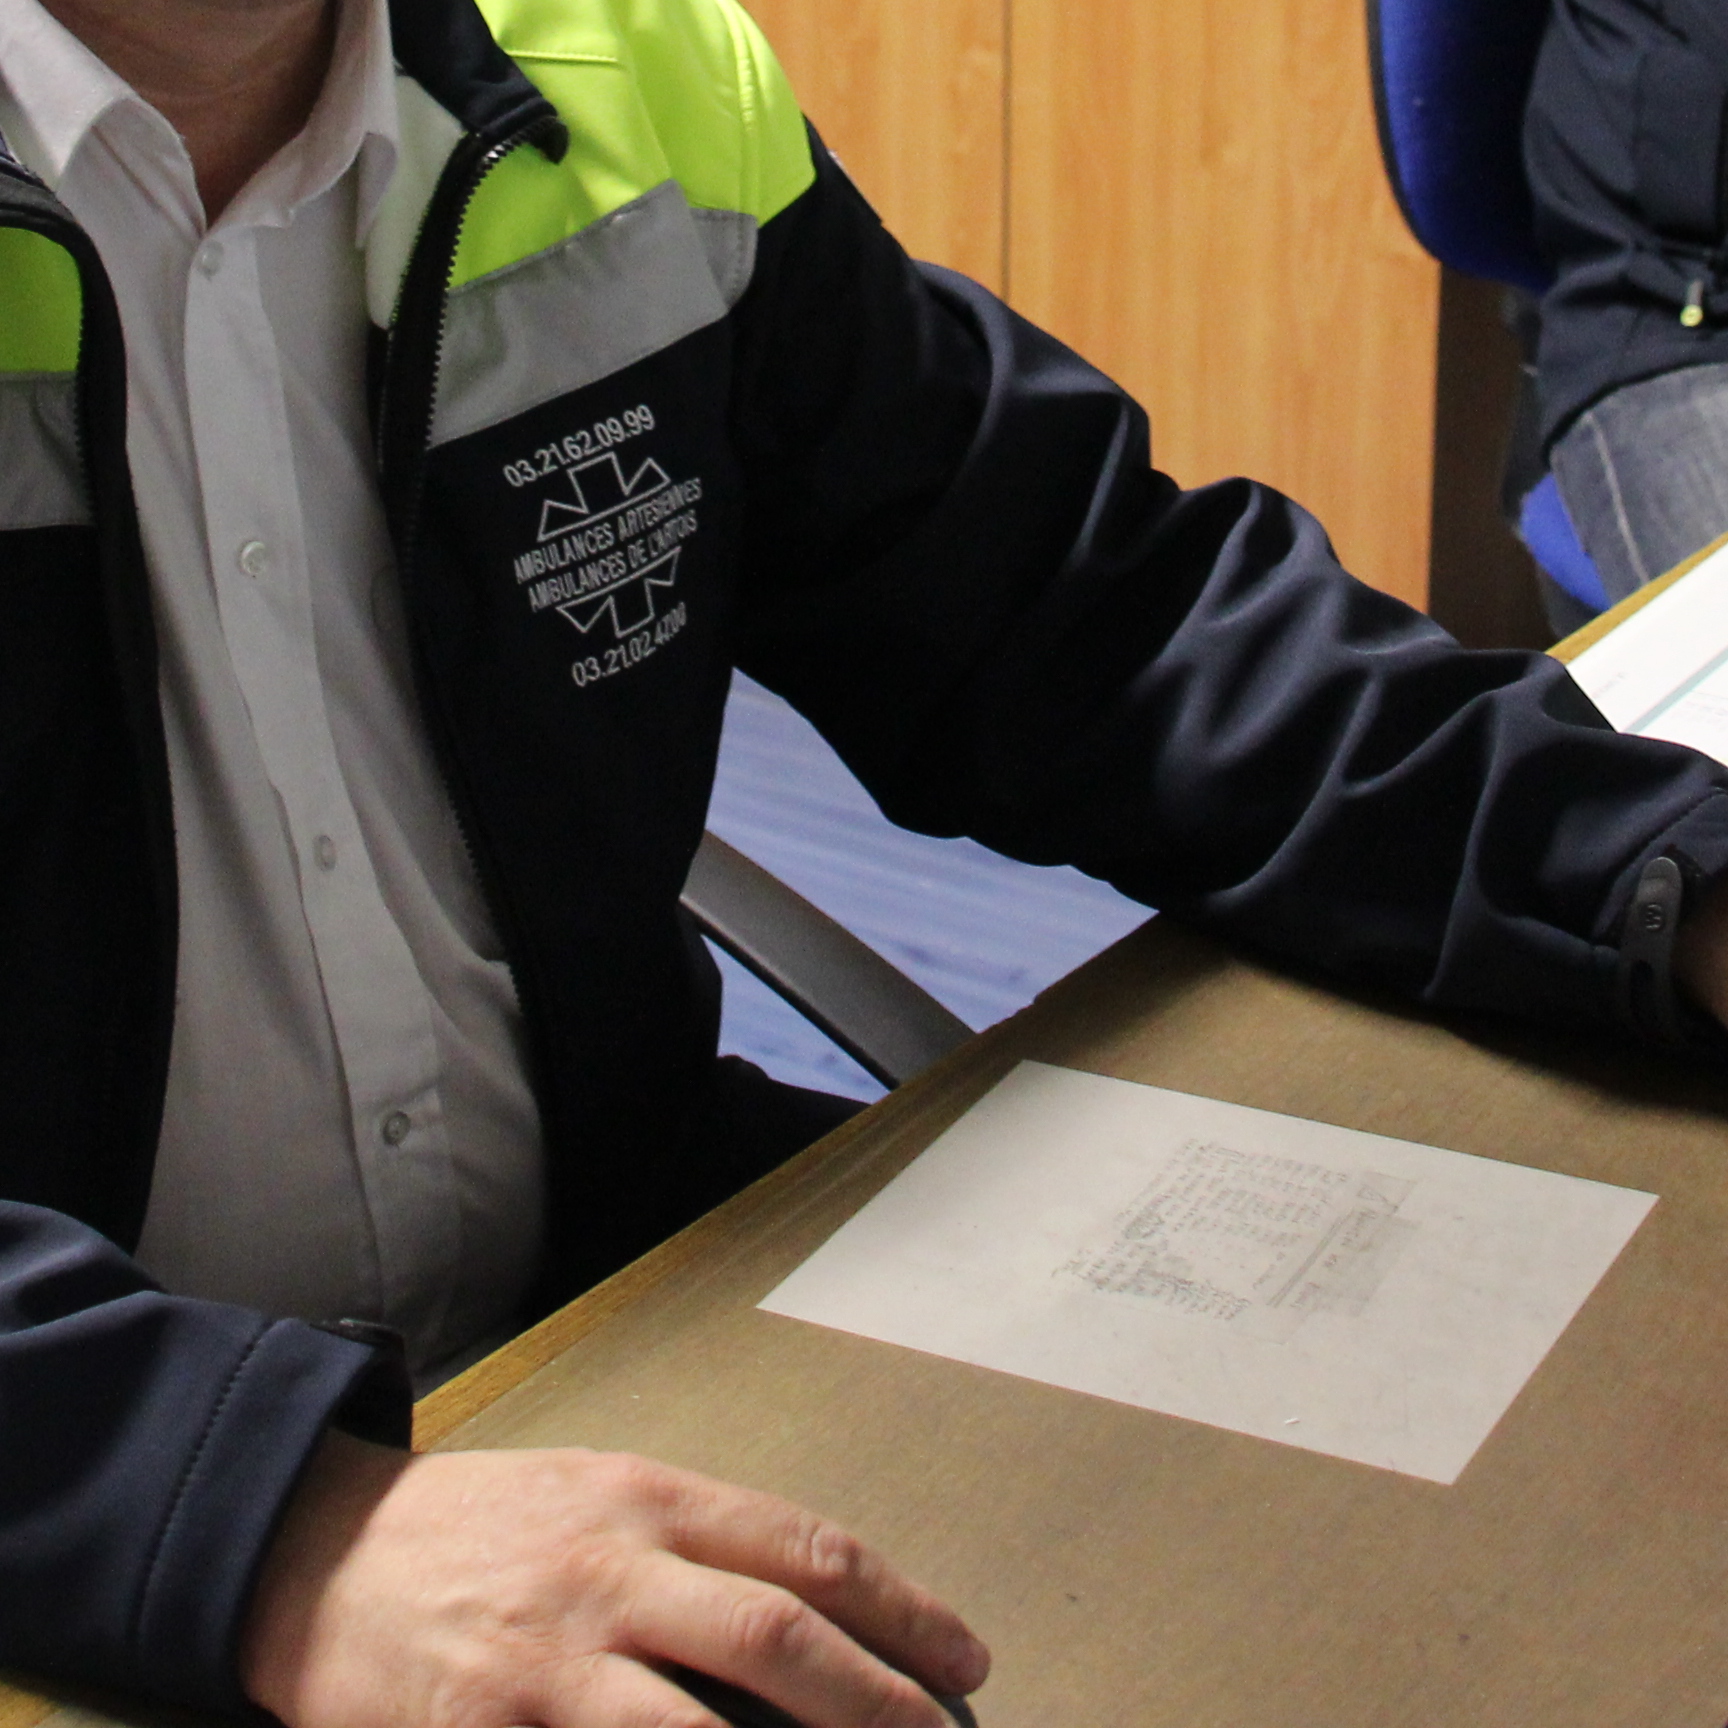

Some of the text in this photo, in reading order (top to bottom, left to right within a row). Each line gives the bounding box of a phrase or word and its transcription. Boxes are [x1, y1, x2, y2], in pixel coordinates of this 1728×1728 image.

[513, 523, 615, 585] AMBULANCES
[528, 551, 628, 613] AMBULANCES
[627, 539, 648, 569] DE
